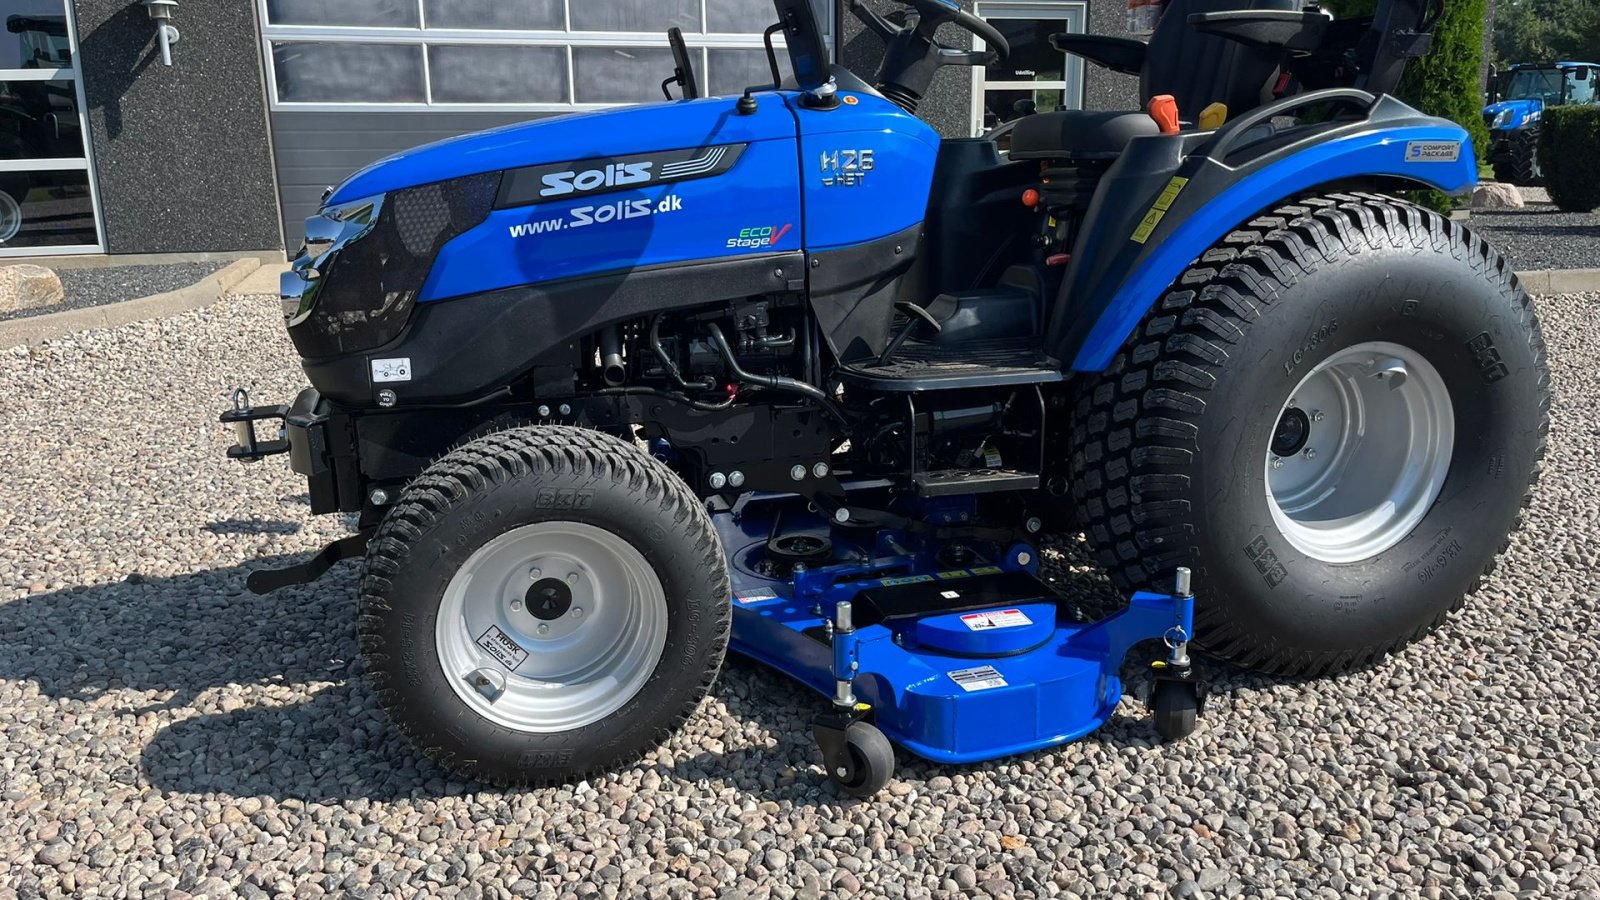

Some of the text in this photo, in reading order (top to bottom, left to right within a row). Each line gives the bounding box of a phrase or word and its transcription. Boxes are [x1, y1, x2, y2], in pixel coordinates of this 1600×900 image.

[820, 149, 874, 172] H26
[740, 226, 772, 238] ECO
[726, 237, 770, 248] Stage
[536, 489, 594, 509] BKT
[1245, 536, 1287, 588] BKT
[496, 633, 520, 654] HUSK
